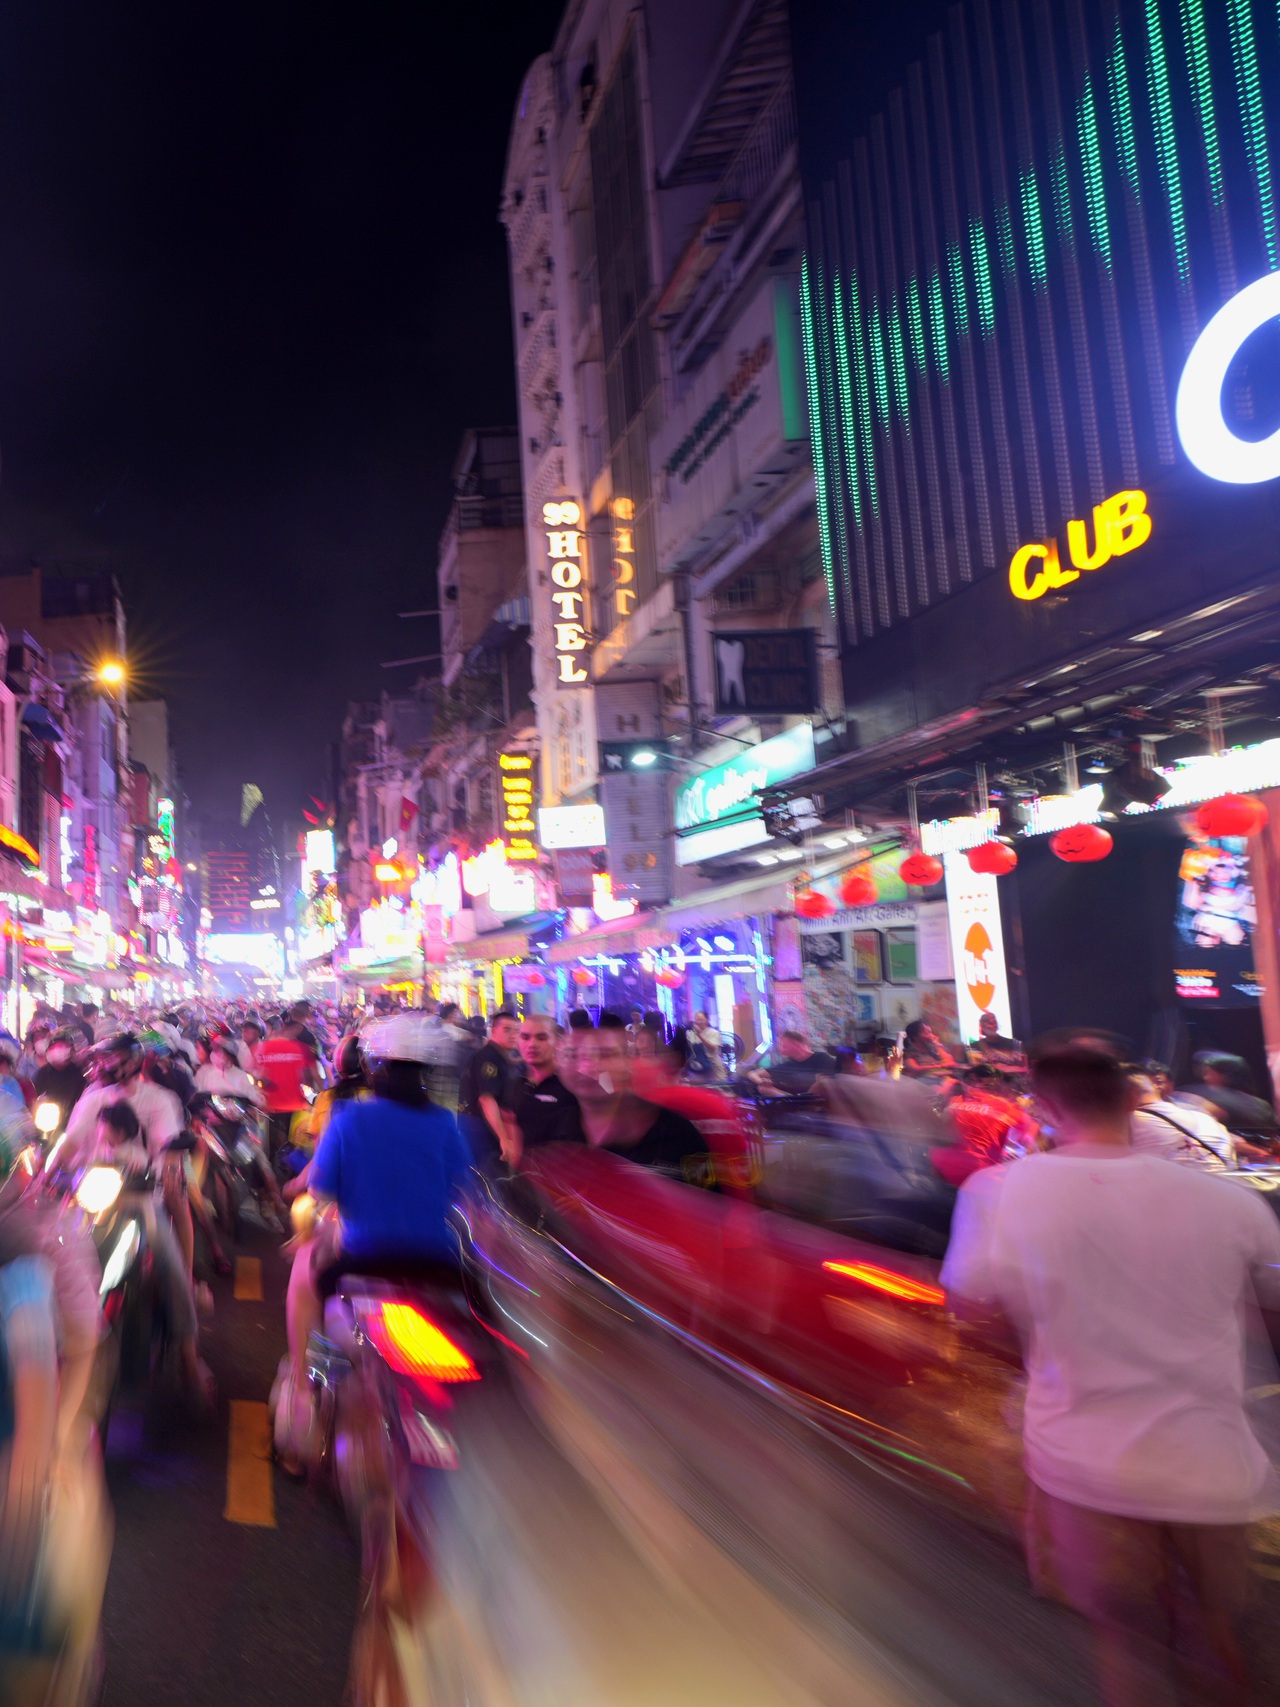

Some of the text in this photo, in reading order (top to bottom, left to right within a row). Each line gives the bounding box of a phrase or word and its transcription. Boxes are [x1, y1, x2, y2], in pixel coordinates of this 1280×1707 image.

[1009, 490, 1152, 600] CLUB
[546, 531, 588, 682] HOTEL
[874, 903, 919, 921] Gallery
